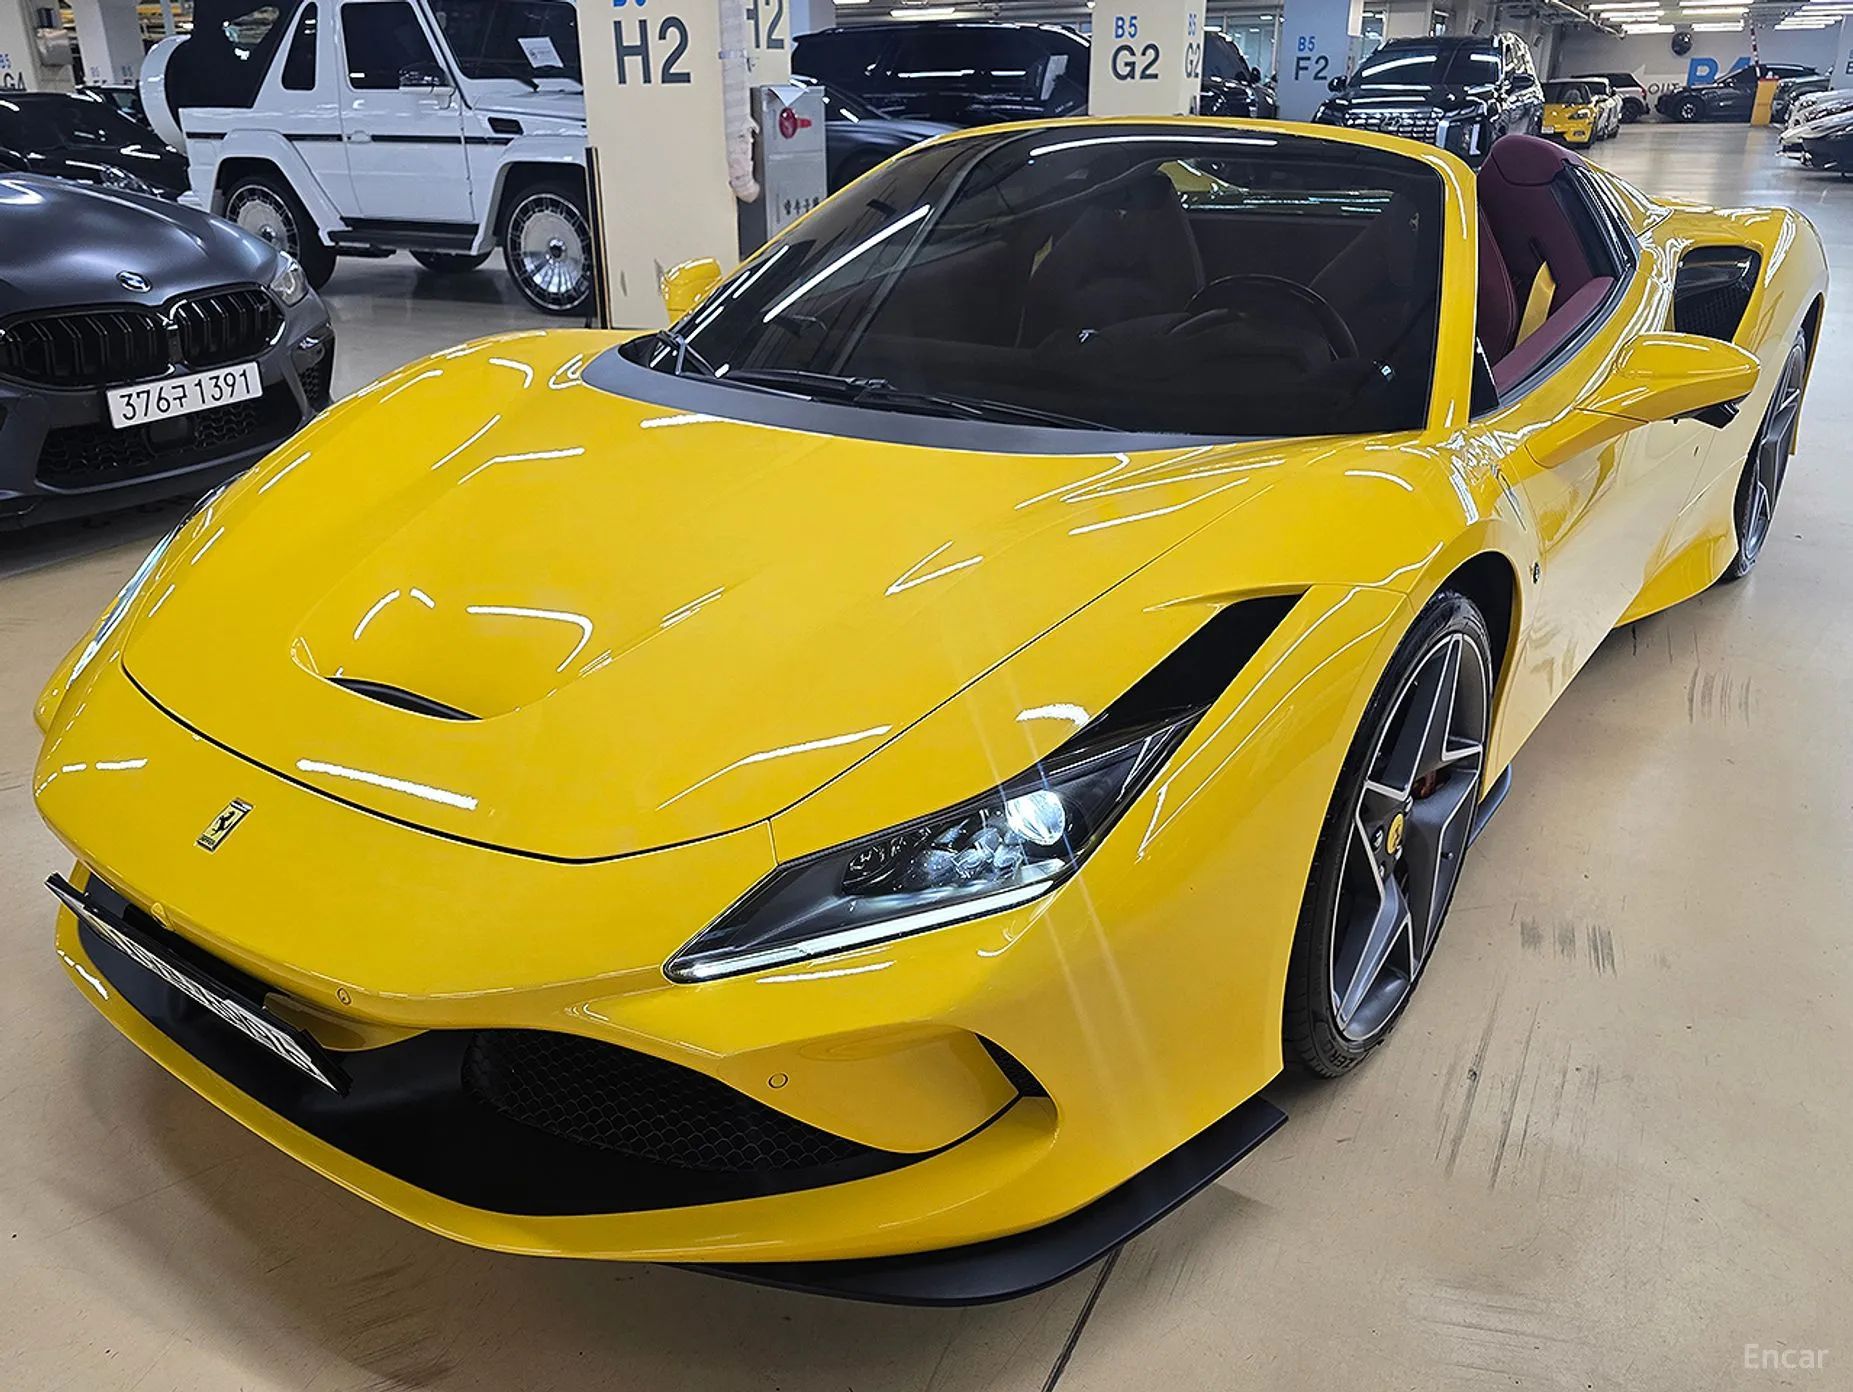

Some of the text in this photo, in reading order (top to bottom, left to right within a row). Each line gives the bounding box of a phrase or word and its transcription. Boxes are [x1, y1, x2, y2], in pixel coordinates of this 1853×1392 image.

[1115, 15, 1138, 39] B5
[1297, 35, 1316, 52] B5
[613, 16, 691, 85] H2
[1111, 43, 1160, 81] G2
[1185, 42, 1200, 79] G2
[1294, 55, 1329, 81] F2
[119, 369, 251, 421] 376구 1391
